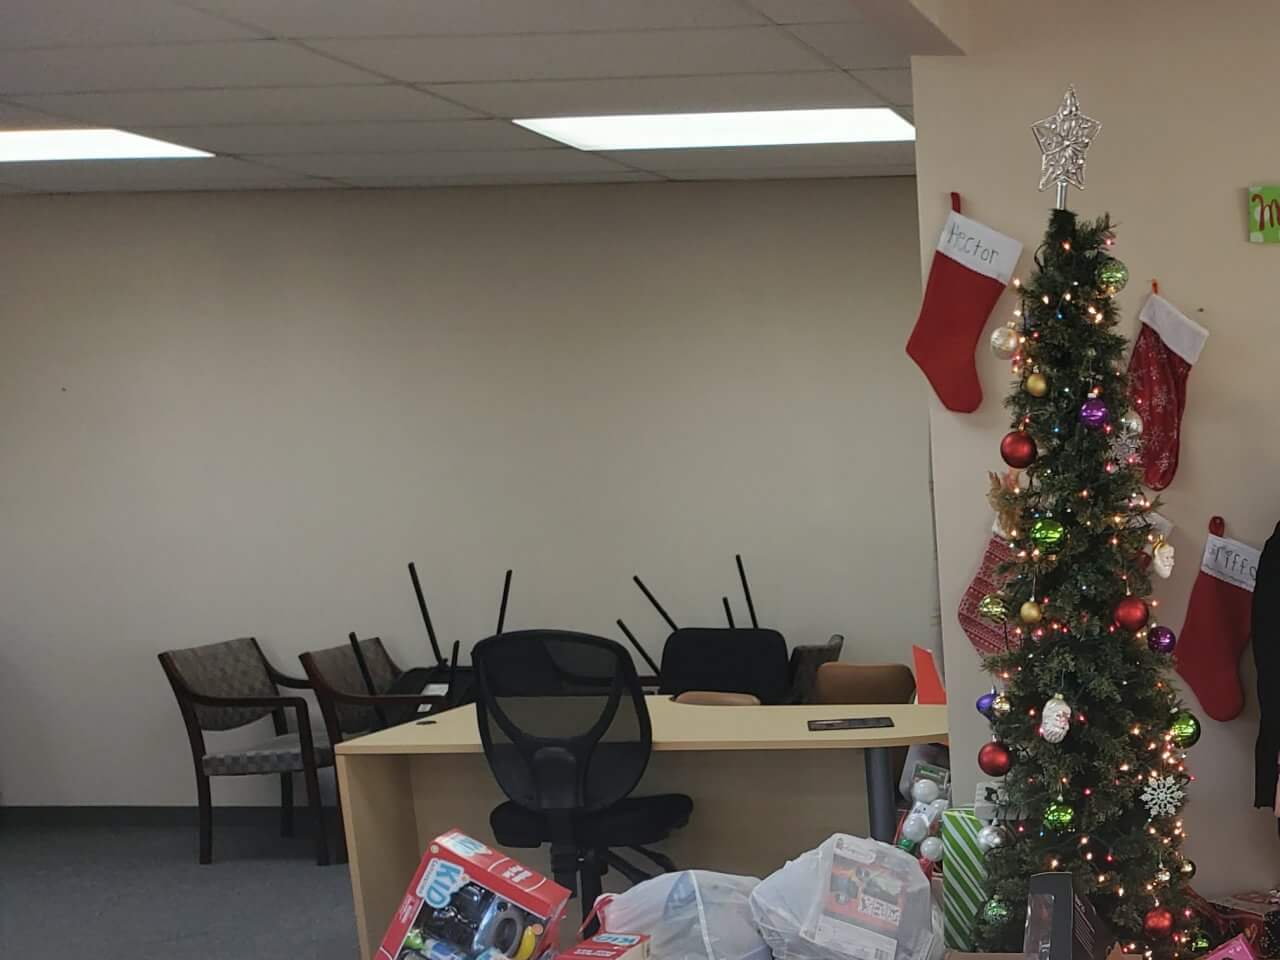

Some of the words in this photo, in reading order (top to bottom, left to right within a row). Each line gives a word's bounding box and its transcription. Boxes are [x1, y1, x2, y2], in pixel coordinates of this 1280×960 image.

[947, 222, 1000, 265] Hector
[427, 862, 463, 907] KID
[594, 933, 637, 945] KID
